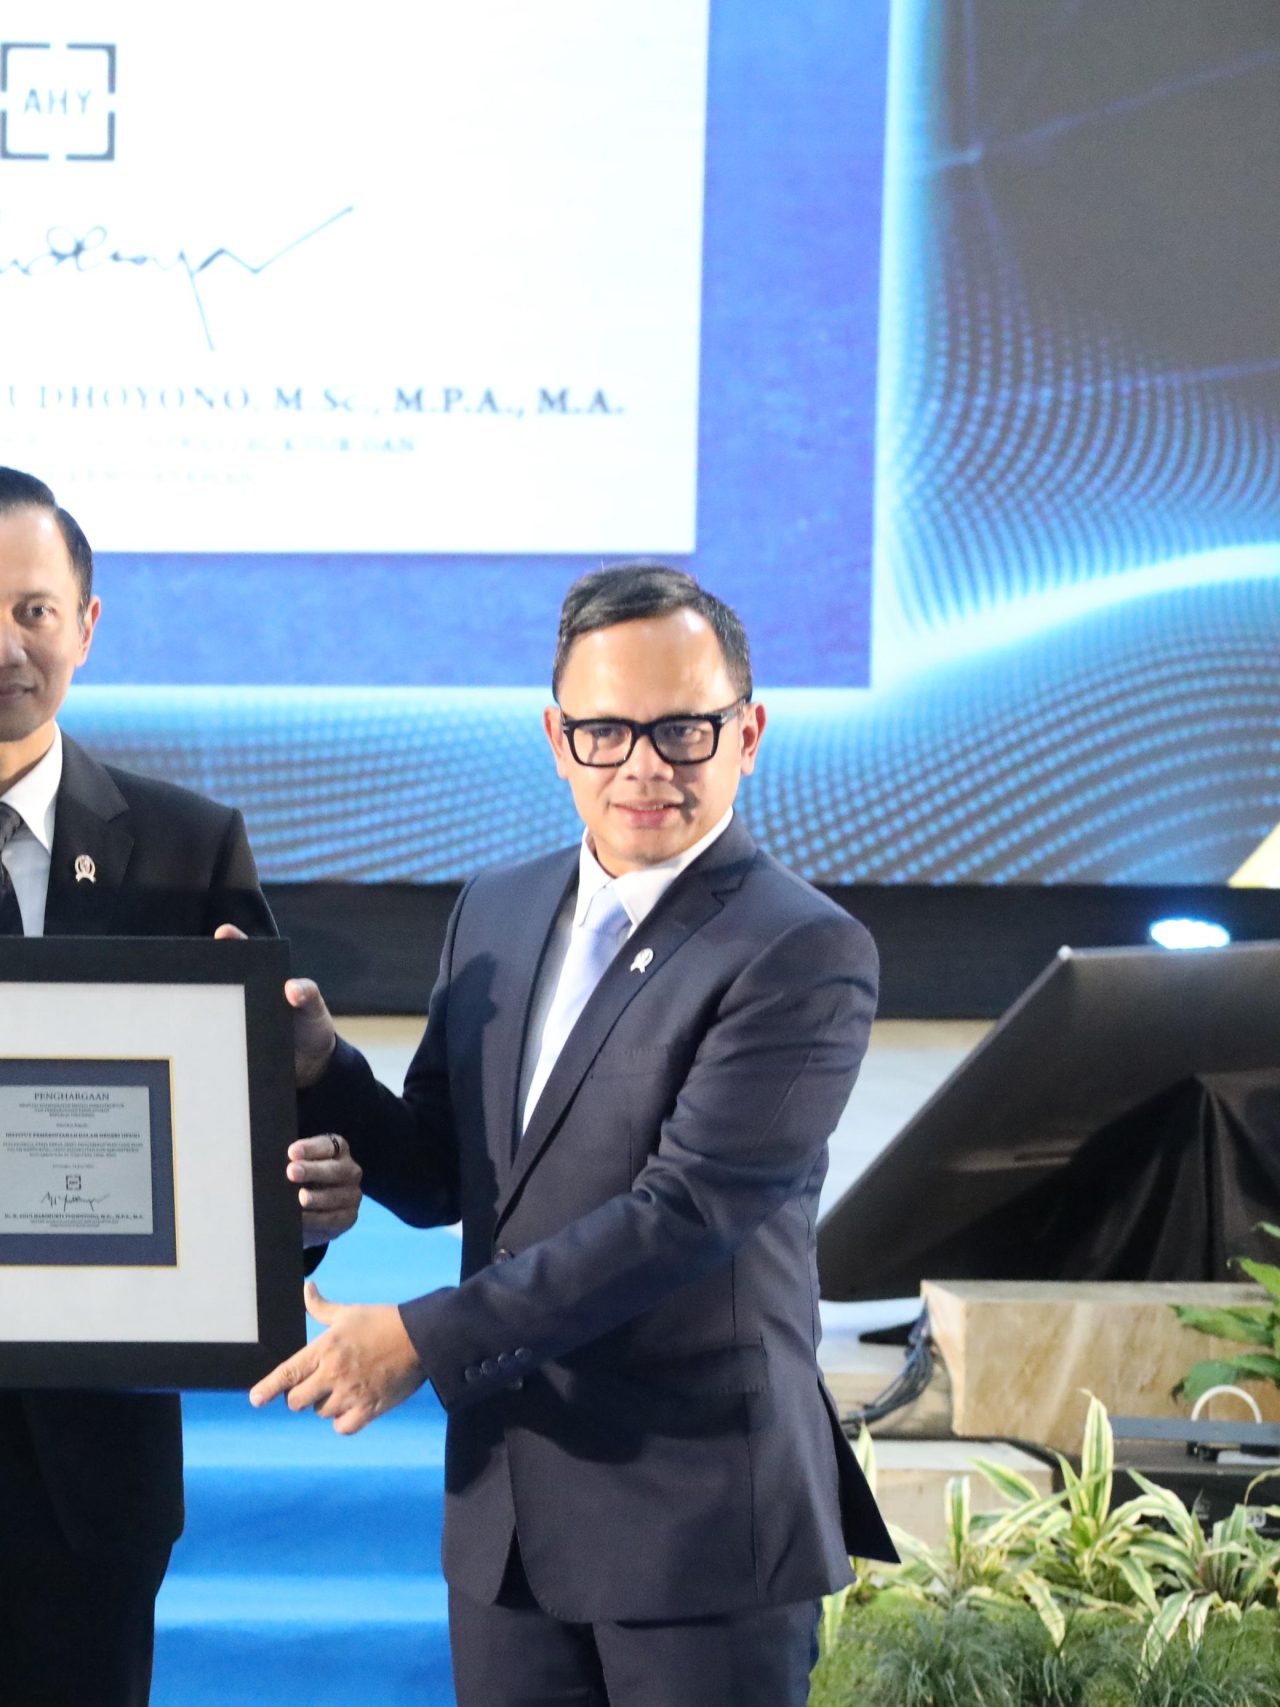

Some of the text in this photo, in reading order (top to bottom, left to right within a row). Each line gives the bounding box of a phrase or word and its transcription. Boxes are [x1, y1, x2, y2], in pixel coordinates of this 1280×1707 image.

[24, 88, 93, 116] AHY
[395, 387, 524, 419] M.P.A.,
[537, 387, 626, 414] M.A.
[34, 1092, 110, 1101] PENGHARGAAN
